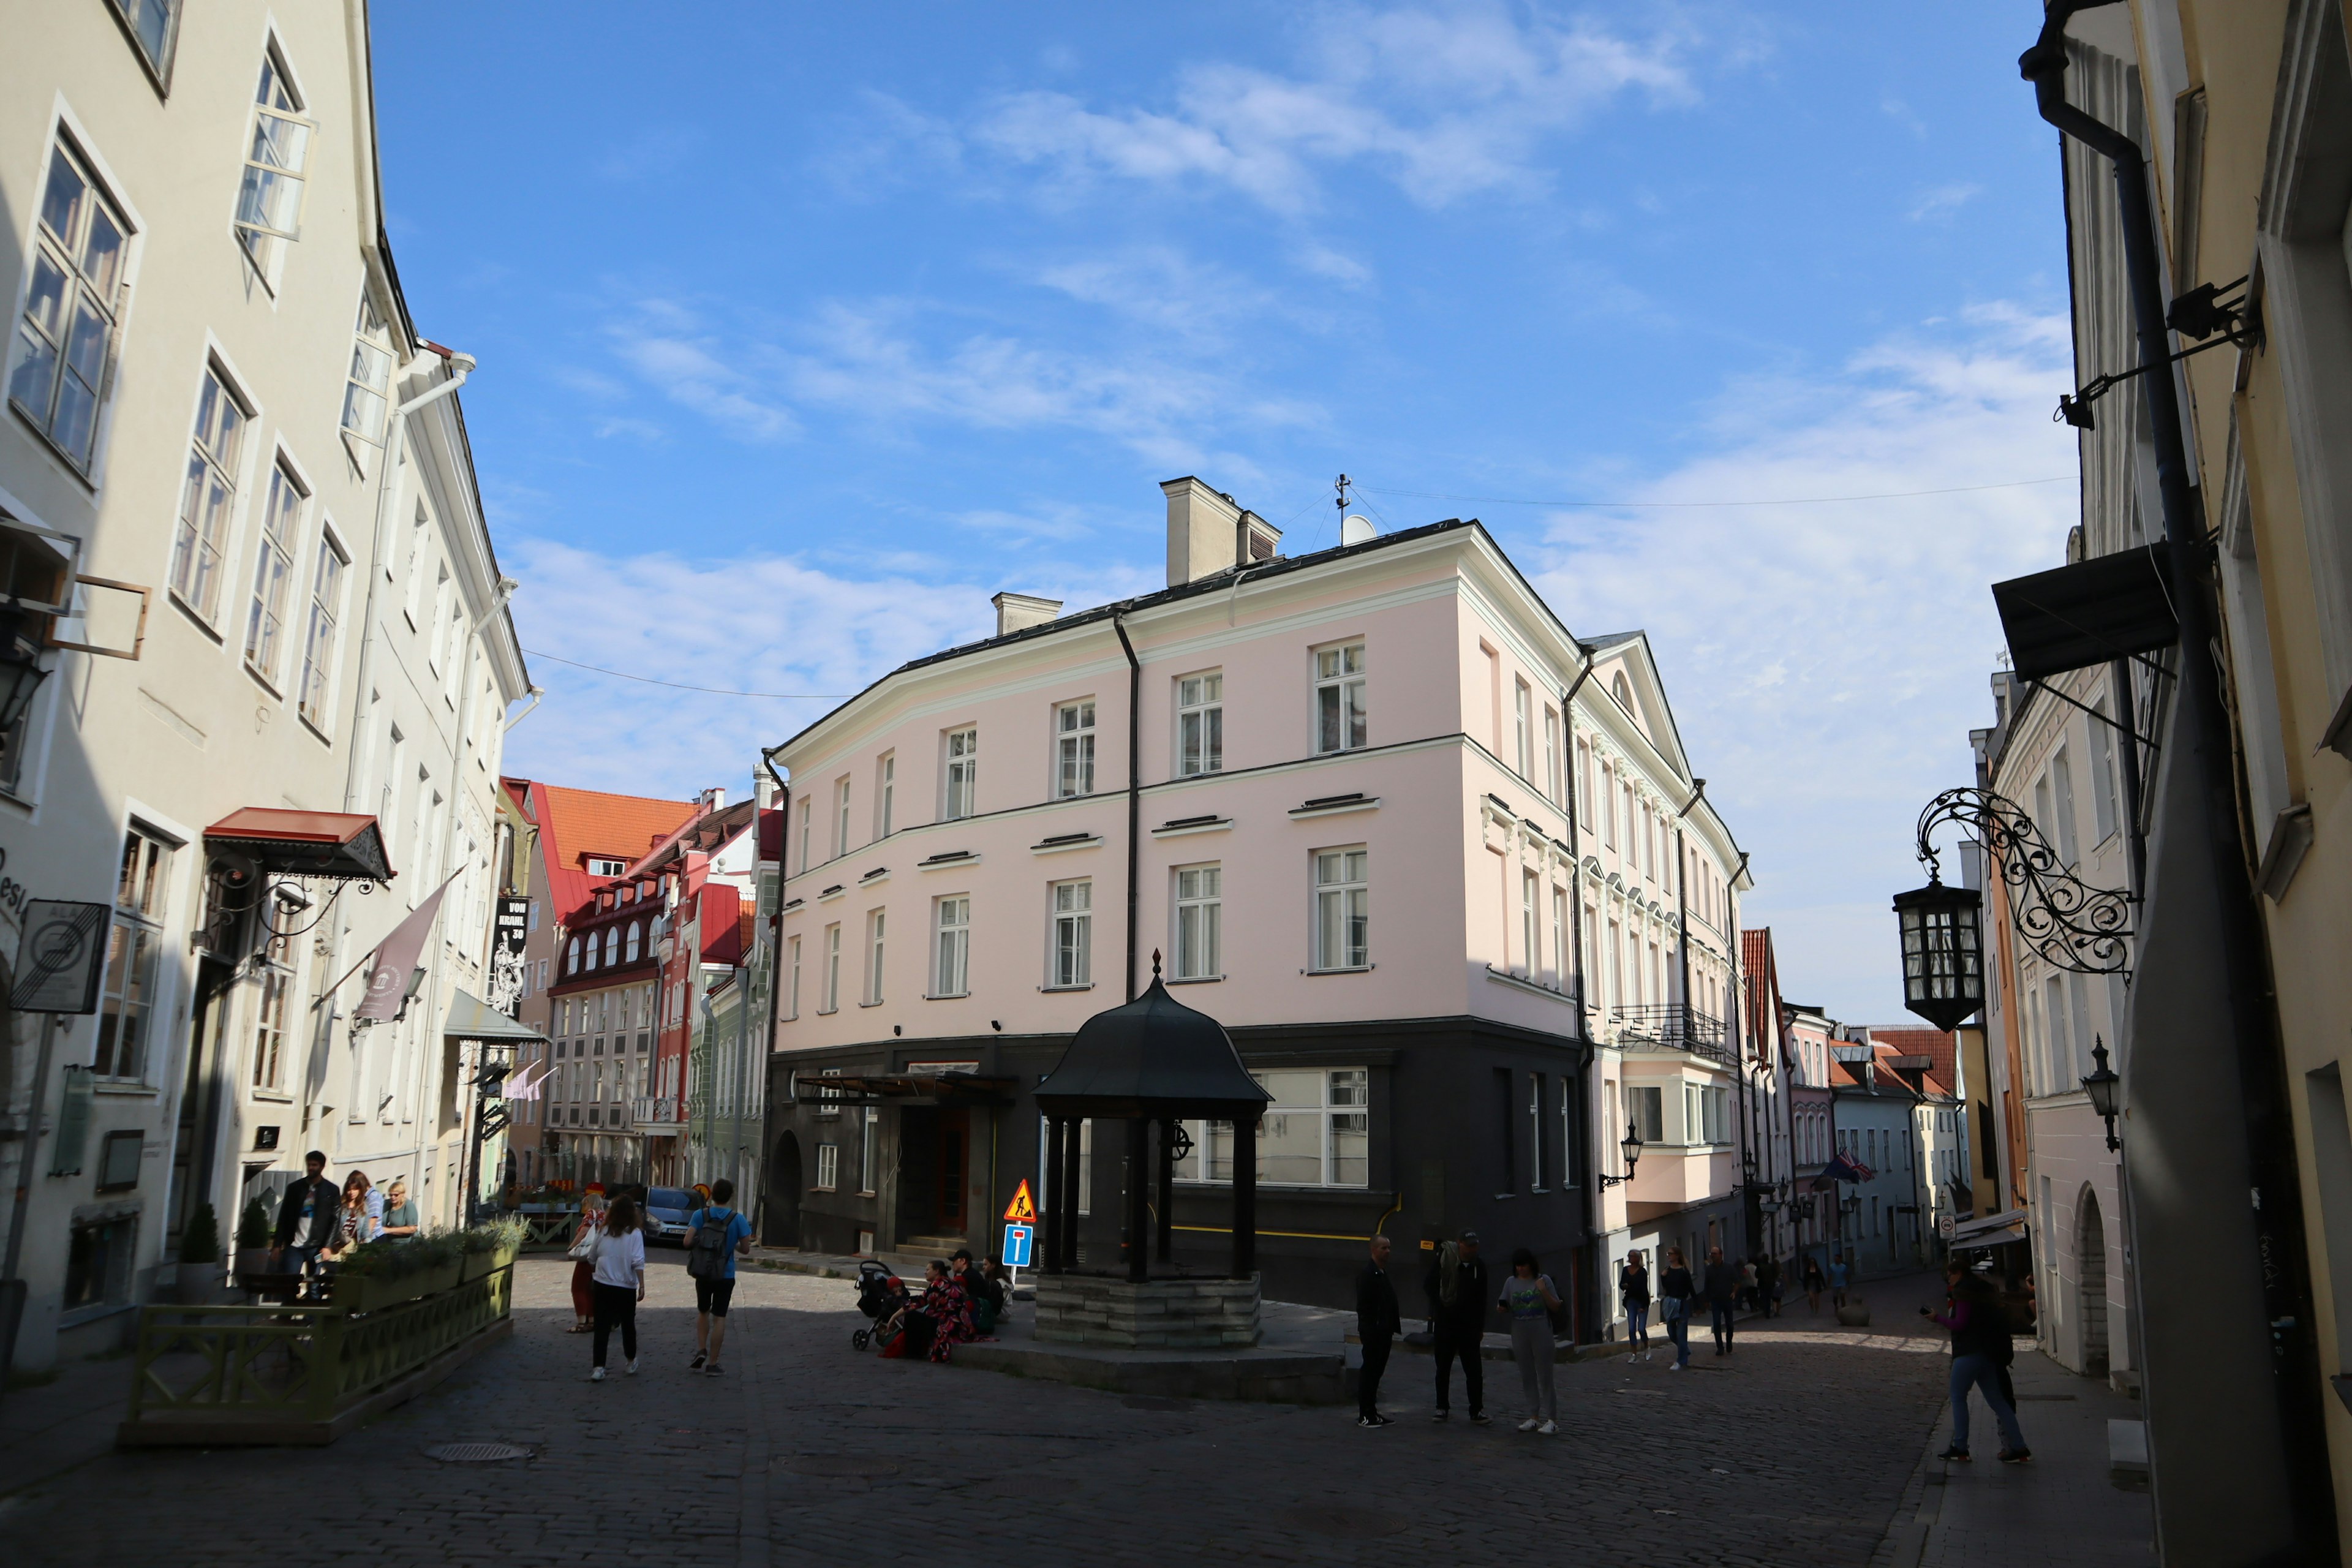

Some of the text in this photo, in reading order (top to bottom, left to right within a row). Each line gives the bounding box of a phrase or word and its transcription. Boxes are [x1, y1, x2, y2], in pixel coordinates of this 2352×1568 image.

[48, 907, 77, 918] ALA
[509, 903, 526, 913] VON
[499, 915, 524, 926] KRAHL
[513, 929, 524, 939] 30
